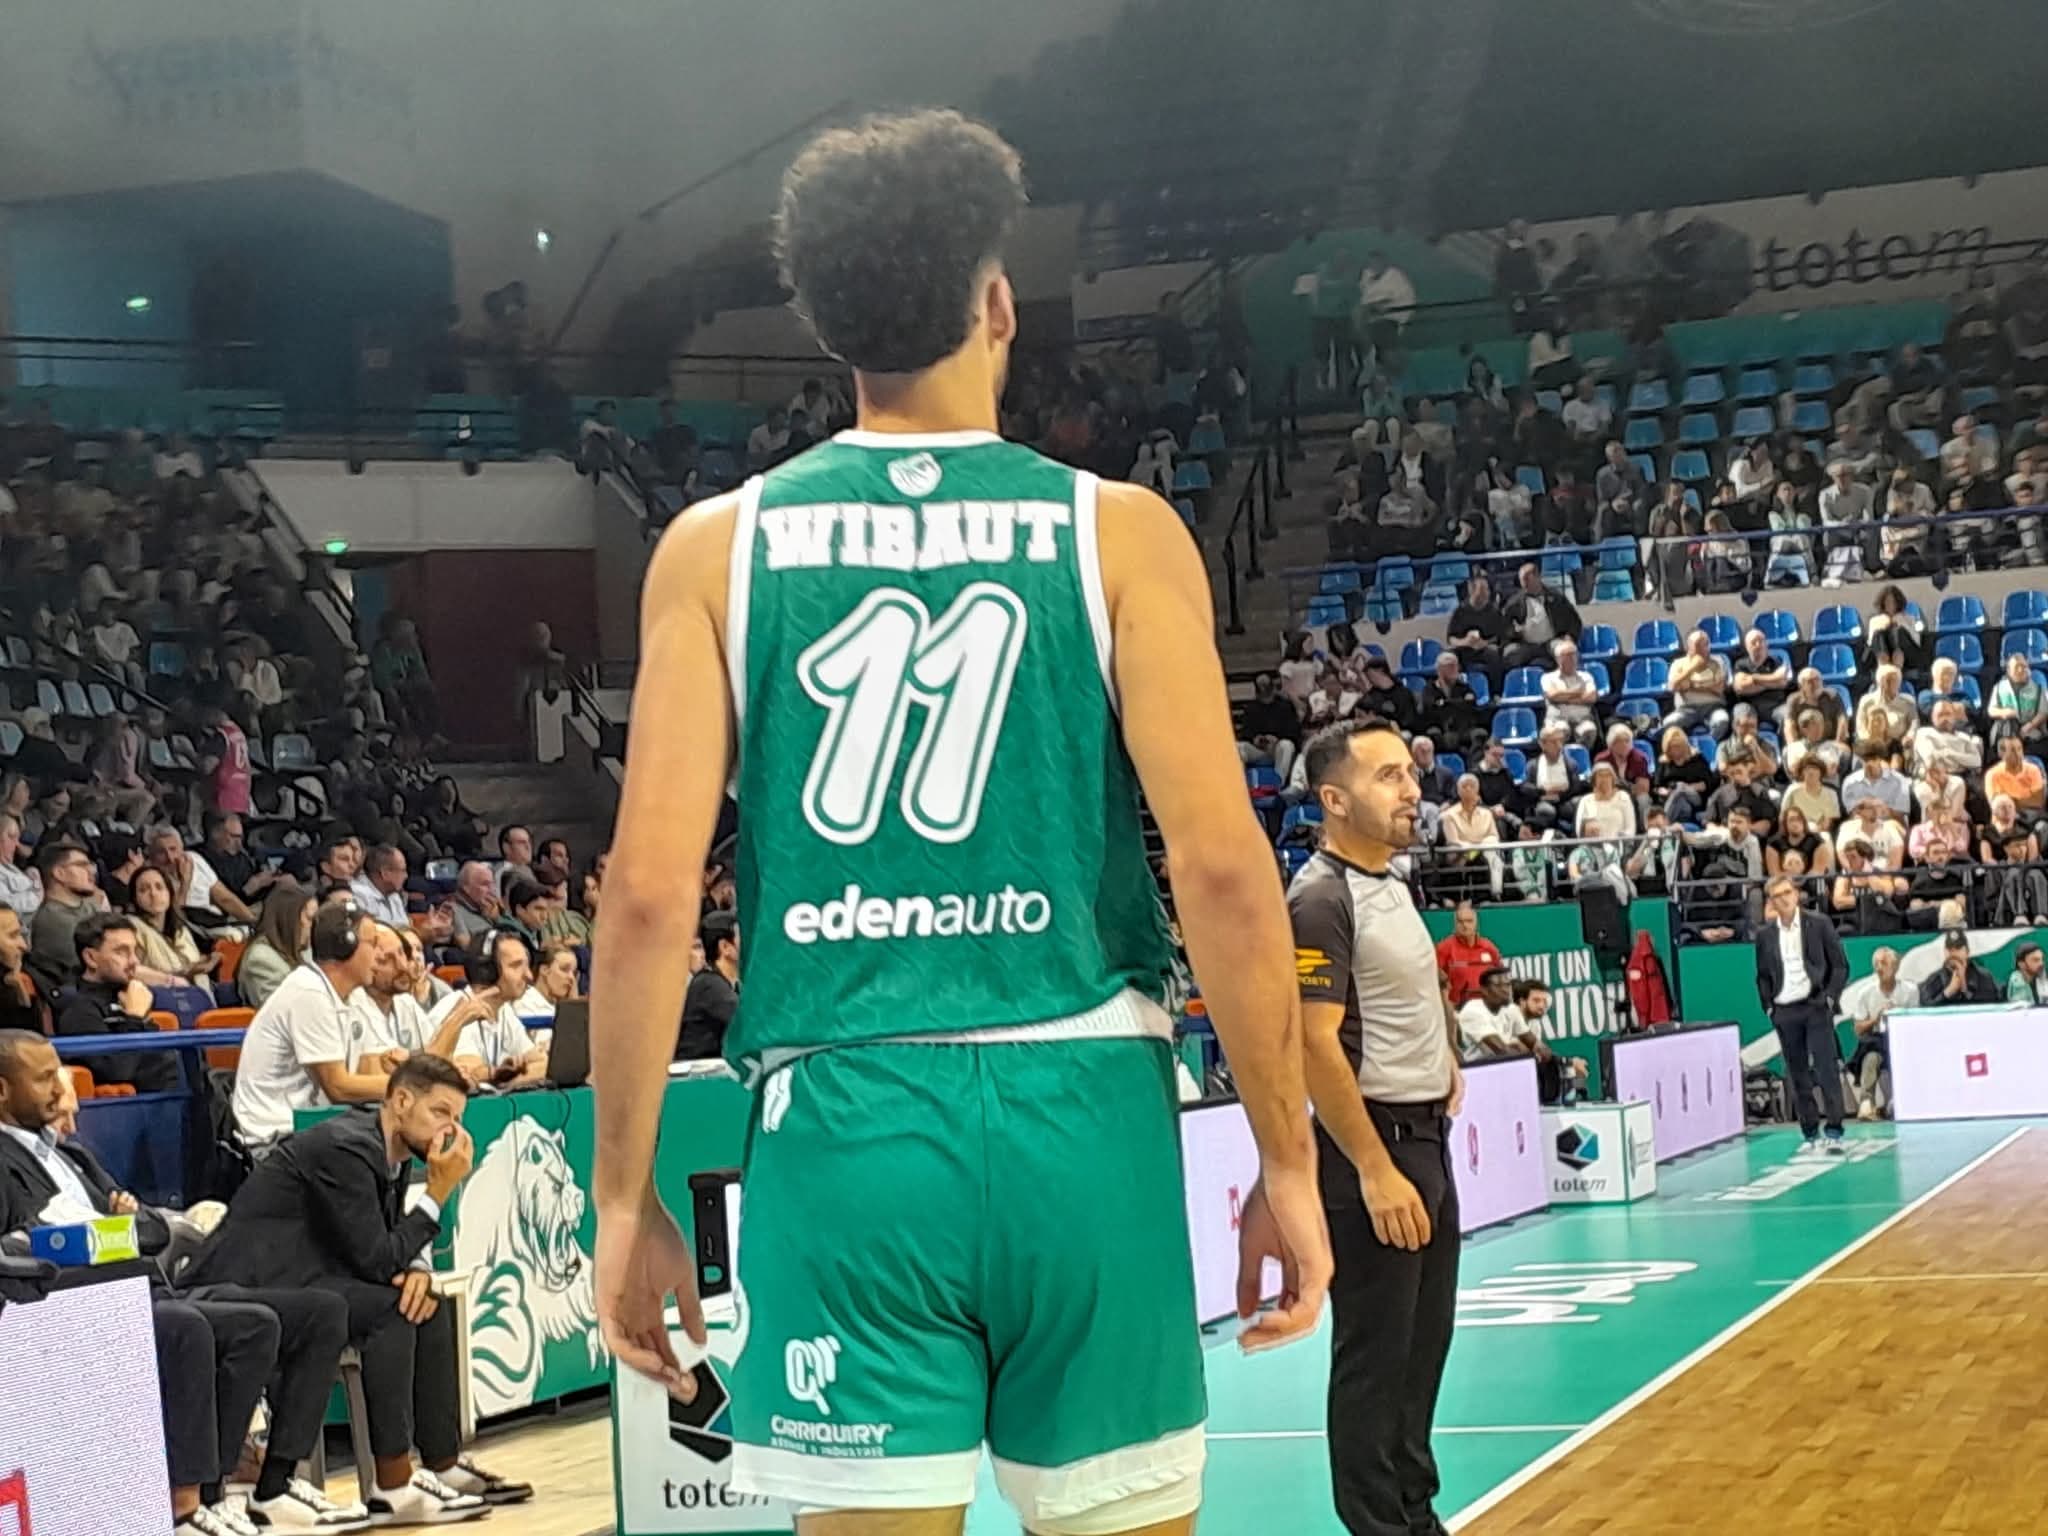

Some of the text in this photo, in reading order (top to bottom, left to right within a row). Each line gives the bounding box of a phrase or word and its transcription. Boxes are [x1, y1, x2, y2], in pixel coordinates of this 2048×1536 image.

[1759, 227, 1989, 291] totem
[759, 499, 1071, 571] WIBAUT
[797, 581, 1028, 845] 11
[784, 884, 1050, 943] edenauto
[1557, 949, 1591, 984] UN
[1554, 1177, 1606, 1193] totem
